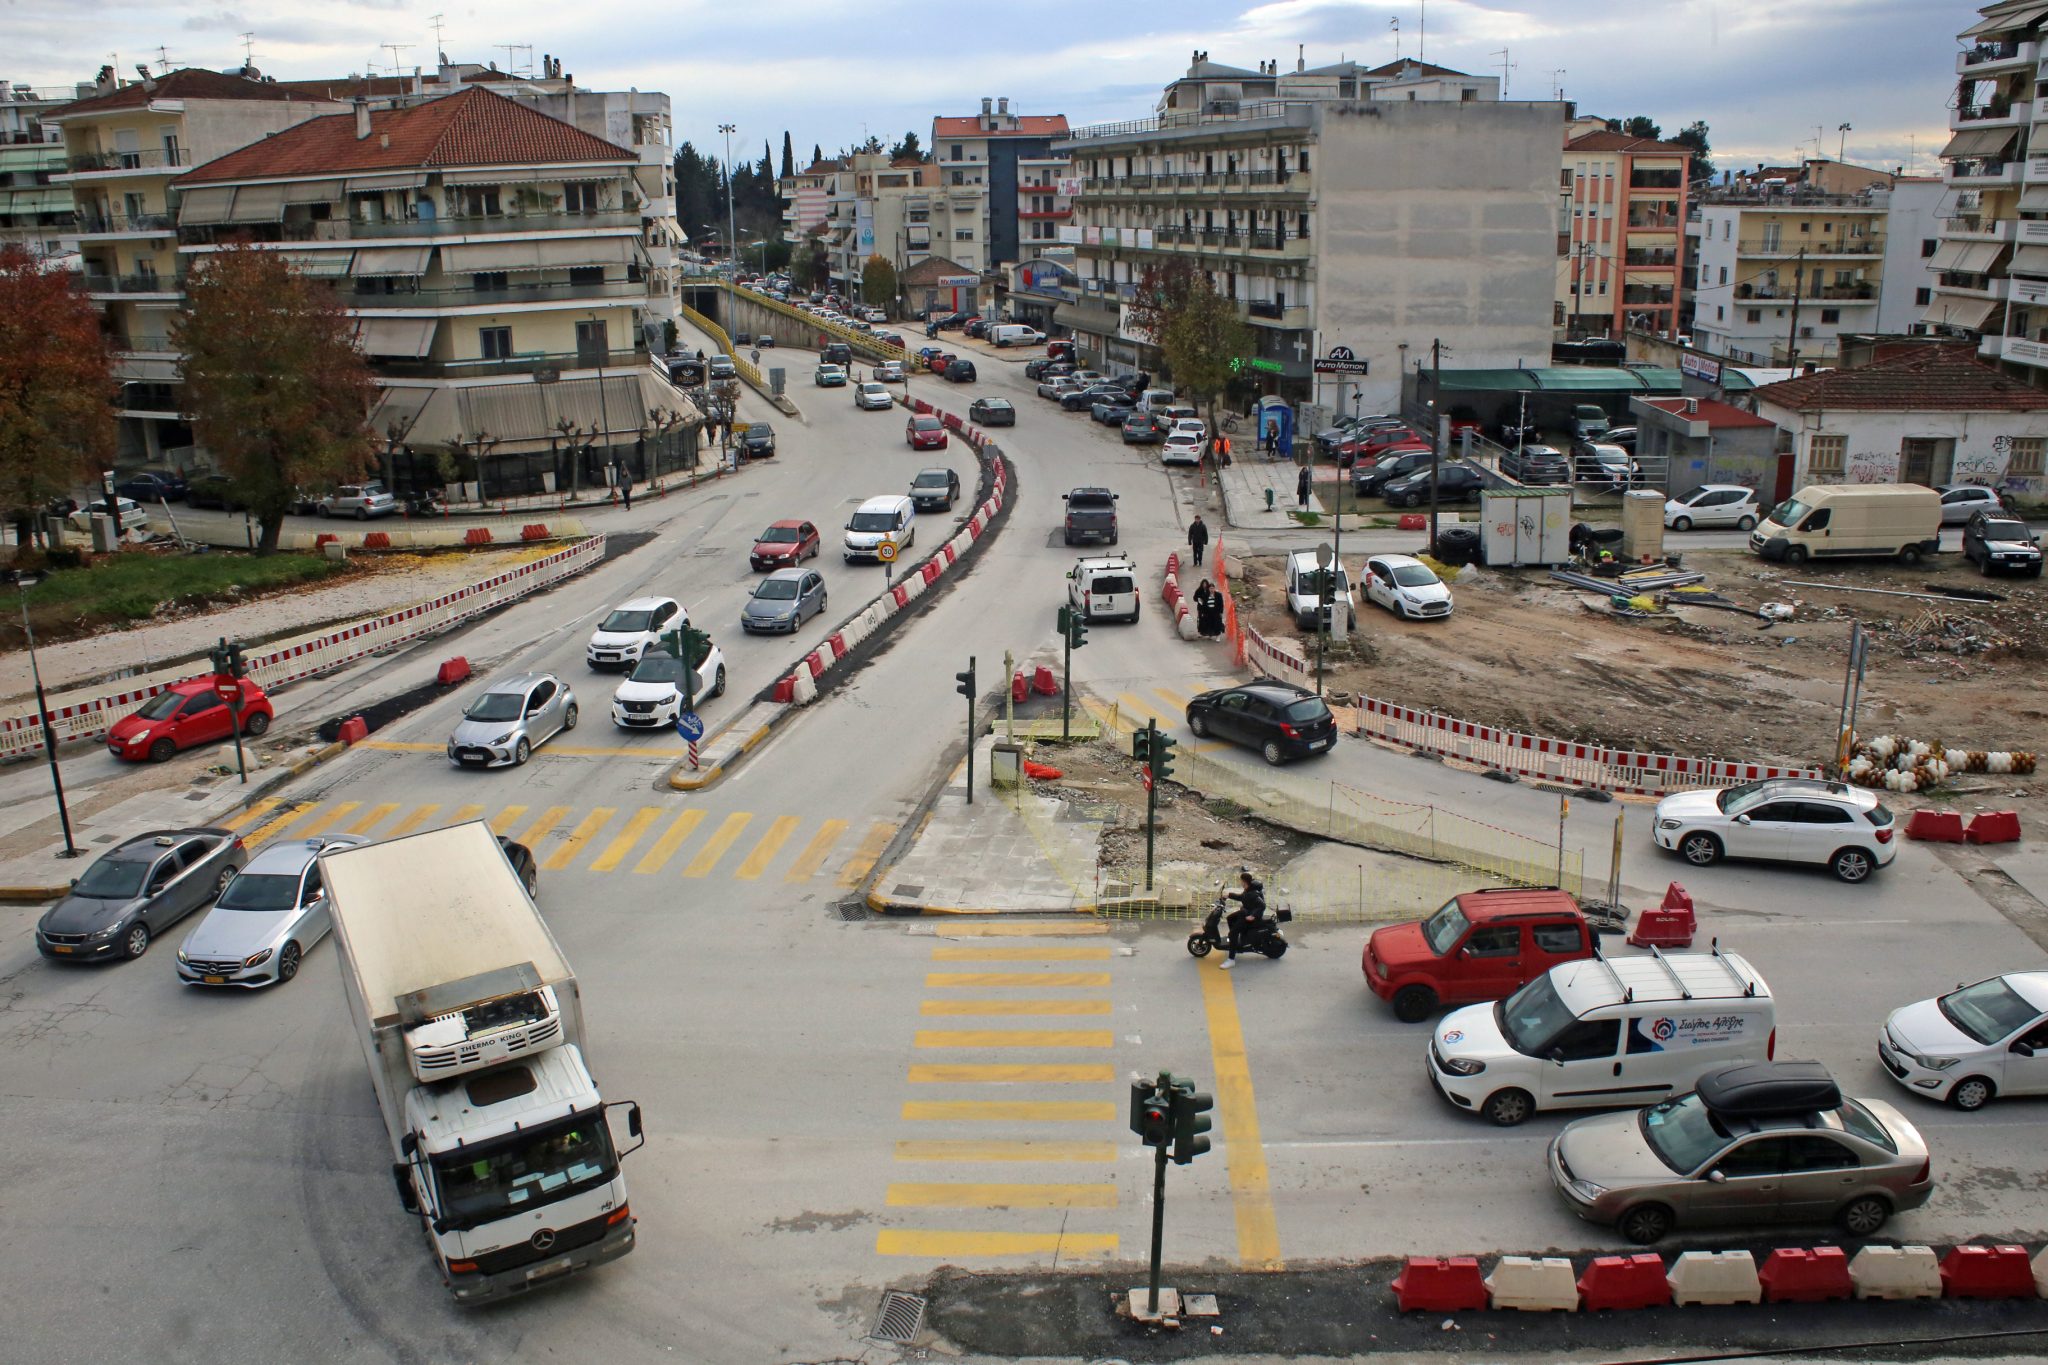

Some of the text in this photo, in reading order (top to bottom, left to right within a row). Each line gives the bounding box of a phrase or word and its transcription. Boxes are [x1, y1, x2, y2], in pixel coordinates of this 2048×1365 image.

[1684, 354, 1719, 375] Auto Motion
[461, 1032, 522, 1053] THERMO KING
